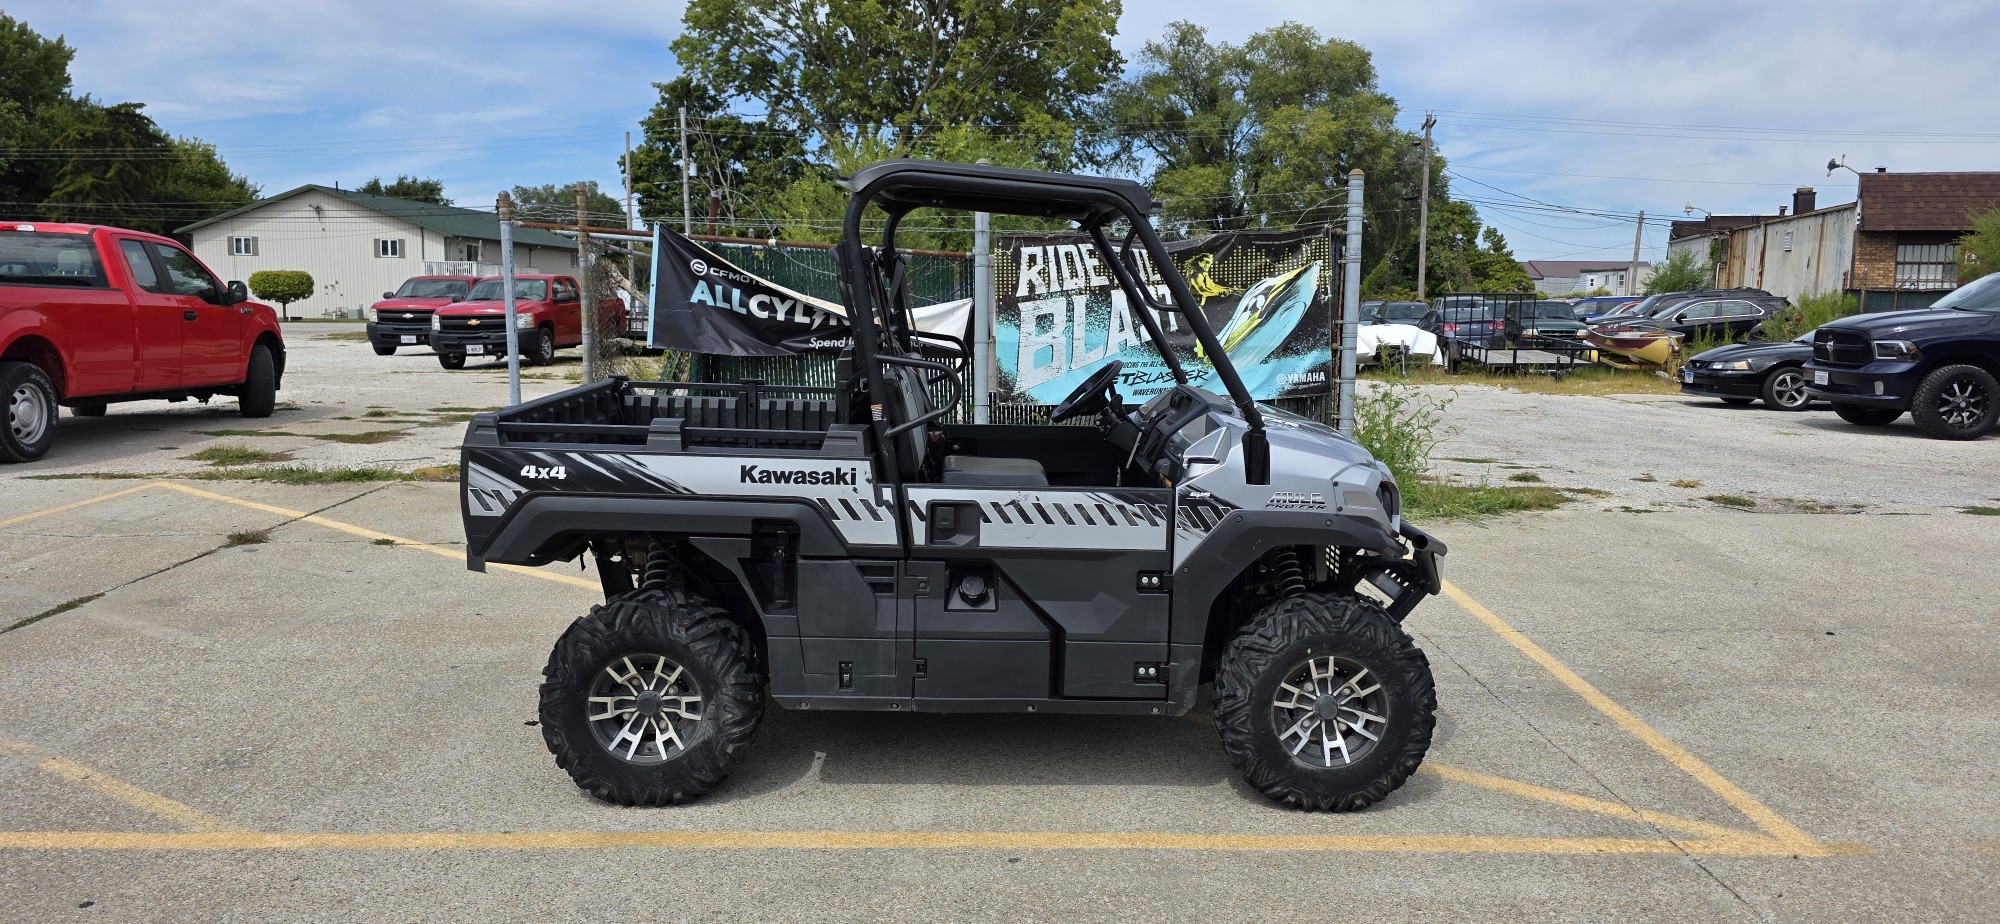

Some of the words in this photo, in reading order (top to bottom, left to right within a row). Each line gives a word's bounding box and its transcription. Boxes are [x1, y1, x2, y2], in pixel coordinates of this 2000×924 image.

[1016, 243, 1109, 297] RIDE
[809, 337, 846, 350] Spend
[1287, 371, 1326, 384] YAMAHA
[520, 464, 567, 479] 4x4
[740, 465, 857, 485] Kawasaki
[1267, 491, 1327, 505] MULE
